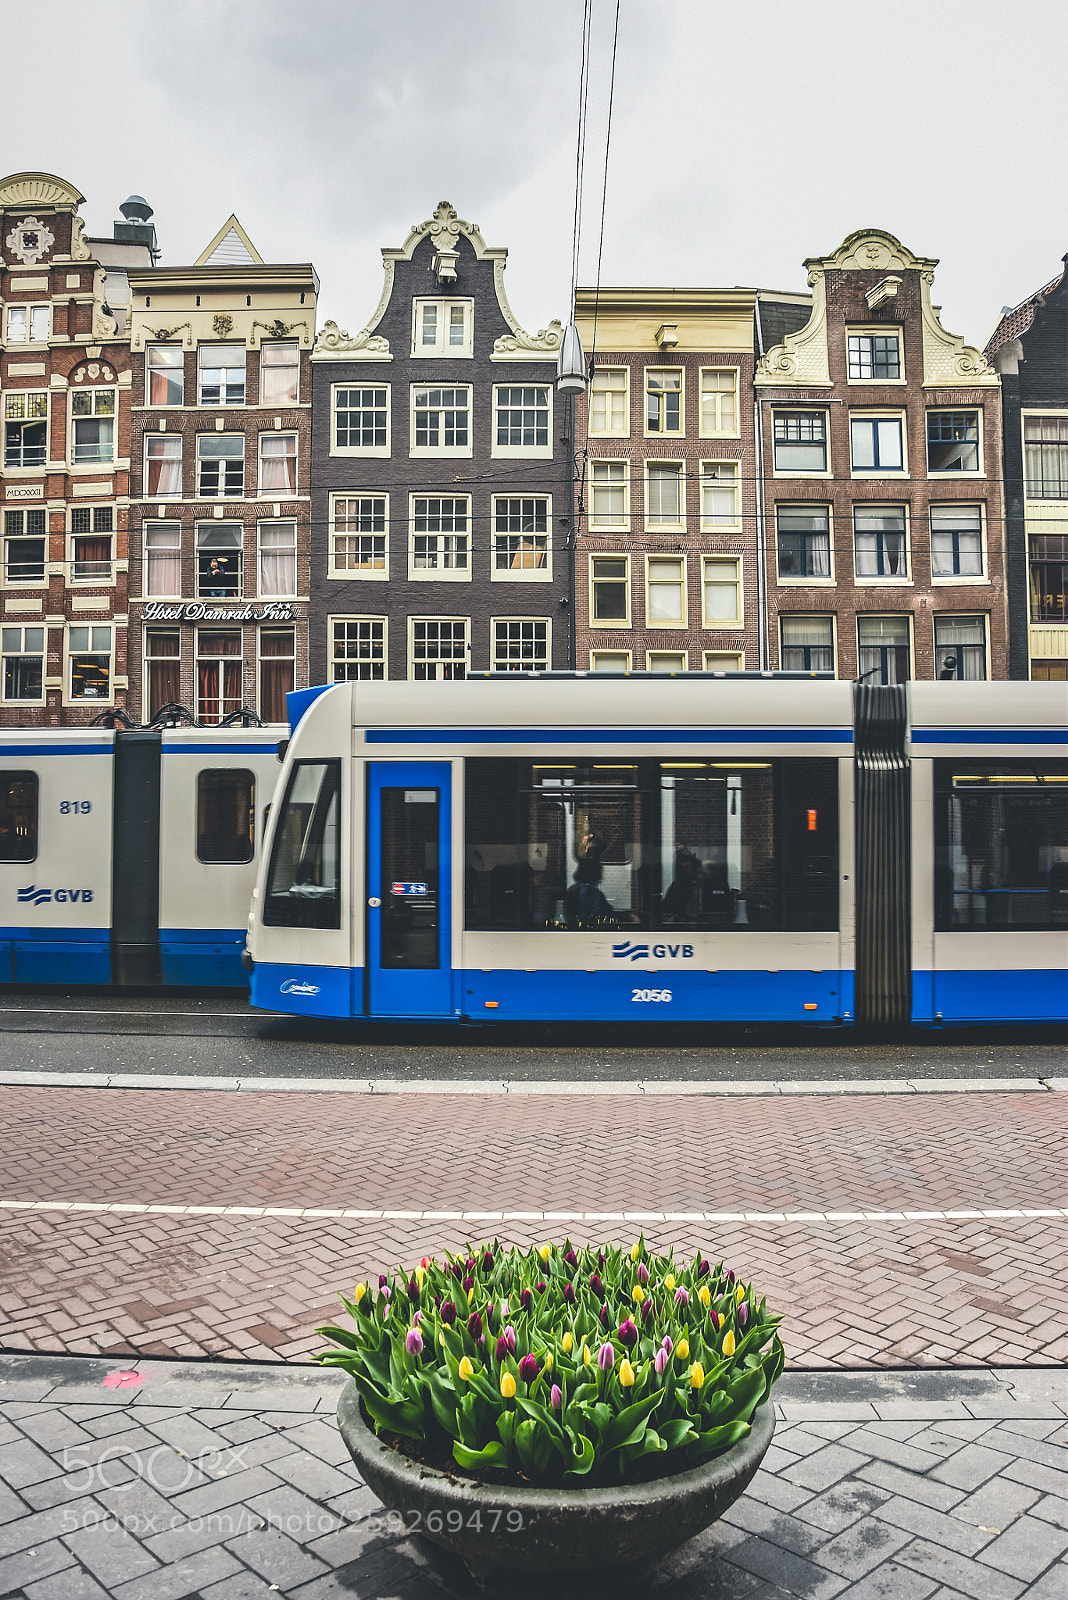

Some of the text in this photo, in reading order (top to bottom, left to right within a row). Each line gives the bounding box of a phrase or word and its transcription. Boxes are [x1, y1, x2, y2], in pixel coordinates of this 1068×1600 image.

[141, 601, 292, 620] Hotel Damrak Inn
[60, 800, 92, 815] 819
[54, 888, 93, 903] GVB
[653, 944, 694, 959] GVB
[631, 988, 673, 1003] 2056
